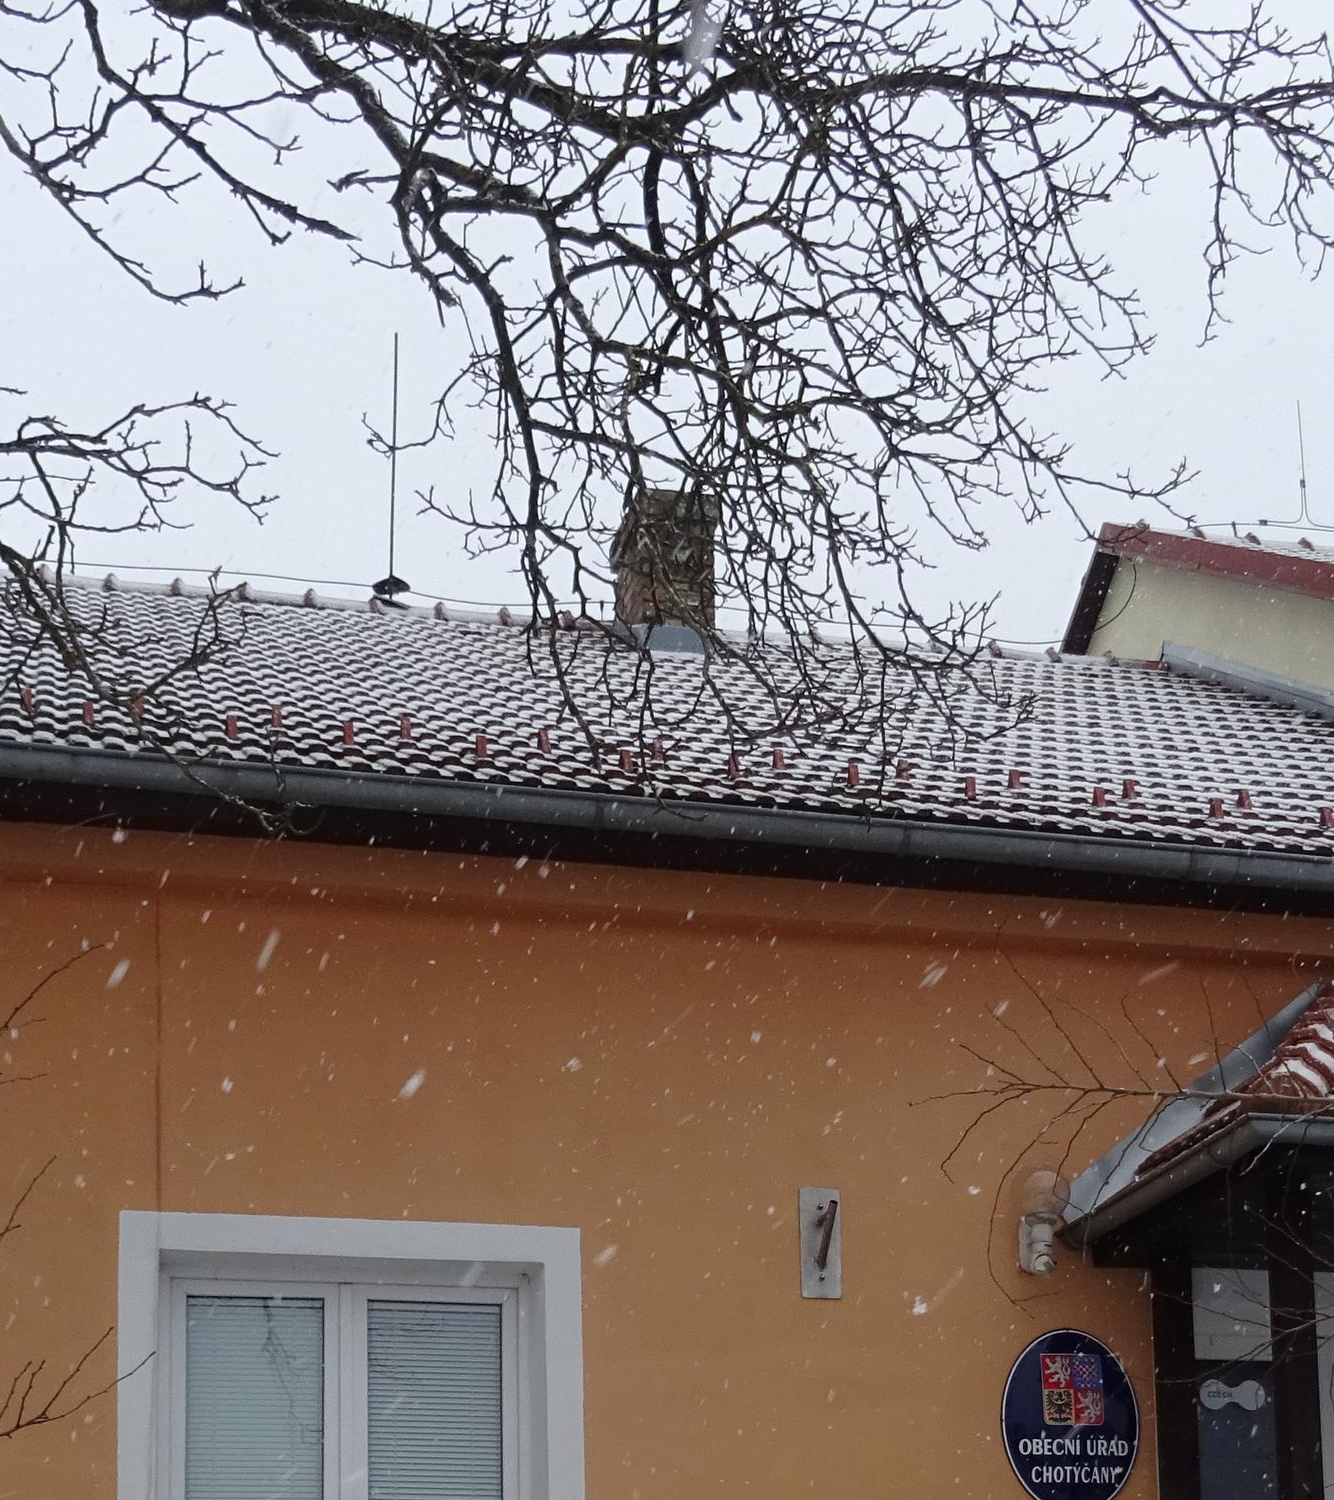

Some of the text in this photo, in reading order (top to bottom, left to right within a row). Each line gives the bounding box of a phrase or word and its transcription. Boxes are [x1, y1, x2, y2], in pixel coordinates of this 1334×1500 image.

[1018, 1434, 1129, 1457] OBECNÍ ÚŘAD
[1031, 1462, 1119, 1484] CHOTÝČANY
